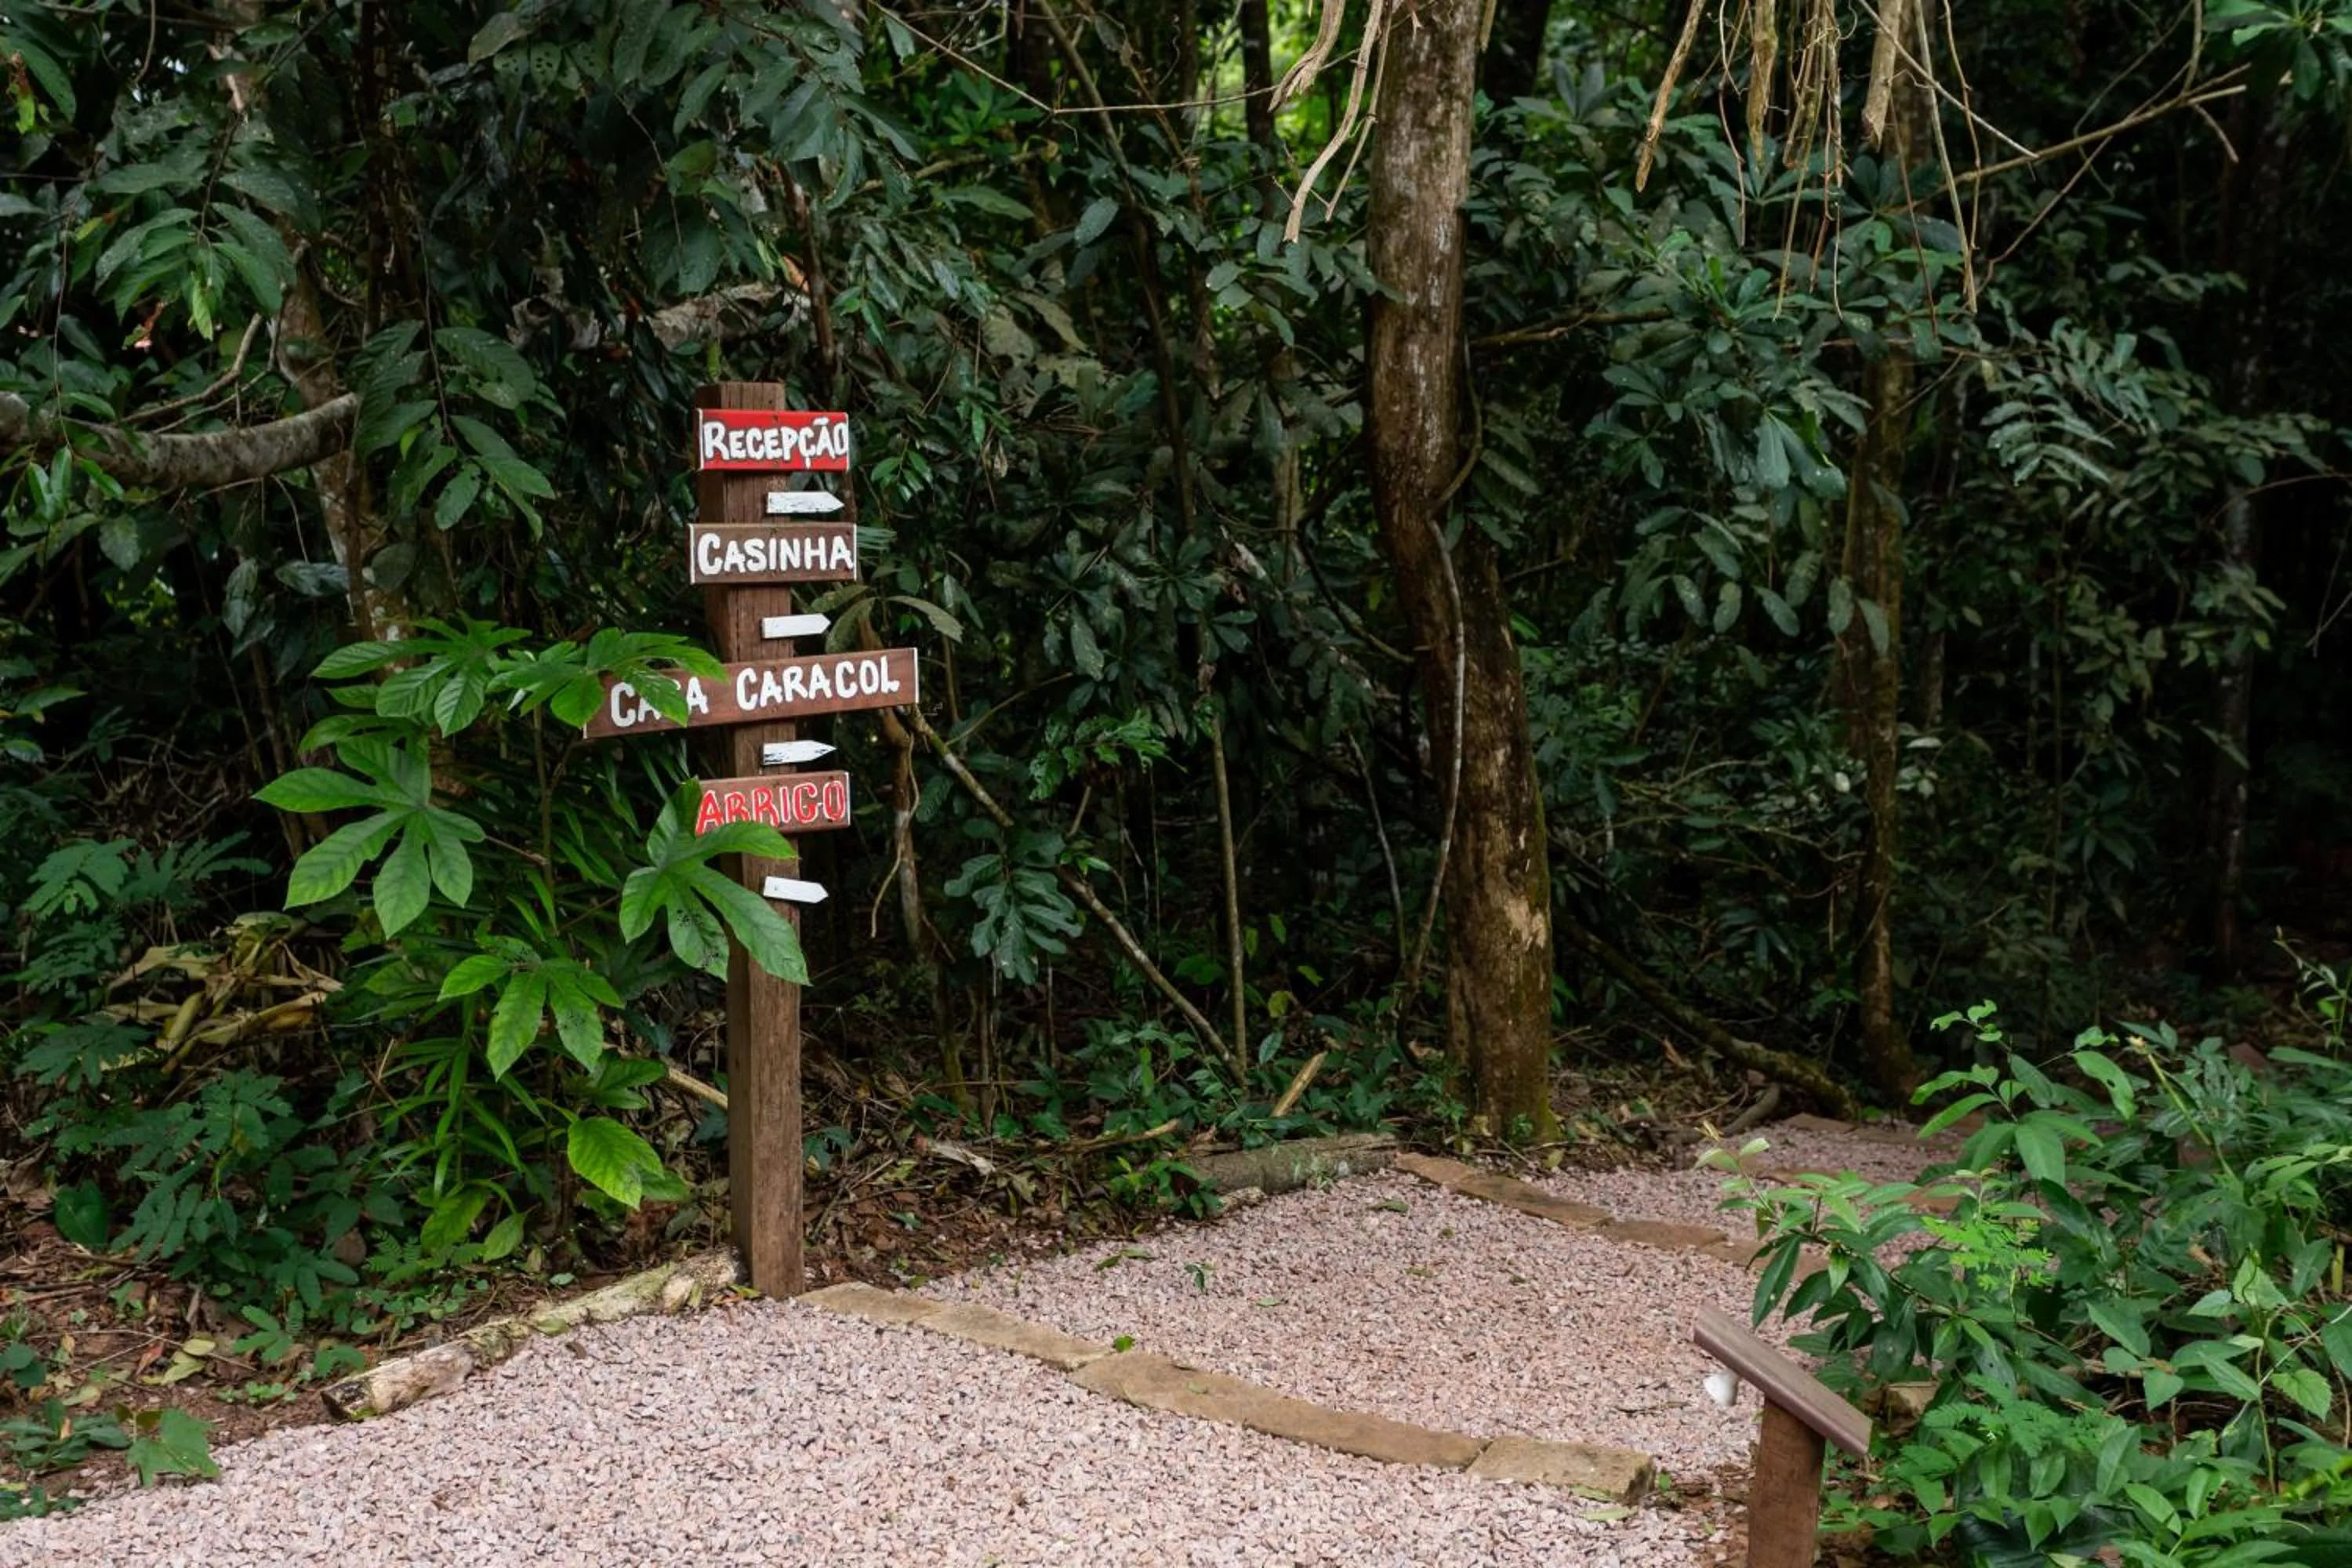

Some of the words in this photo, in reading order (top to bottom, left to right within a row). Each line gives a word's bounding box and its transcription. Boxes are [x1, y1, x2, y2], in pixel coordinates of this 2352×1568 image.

[702, 417, 848, 469] RECEPÇÃO
[697, 533, 854, 575] CASINHA
[611, 677, 710, 728] CAA
[736, 655, 900, 711] CARACOL
